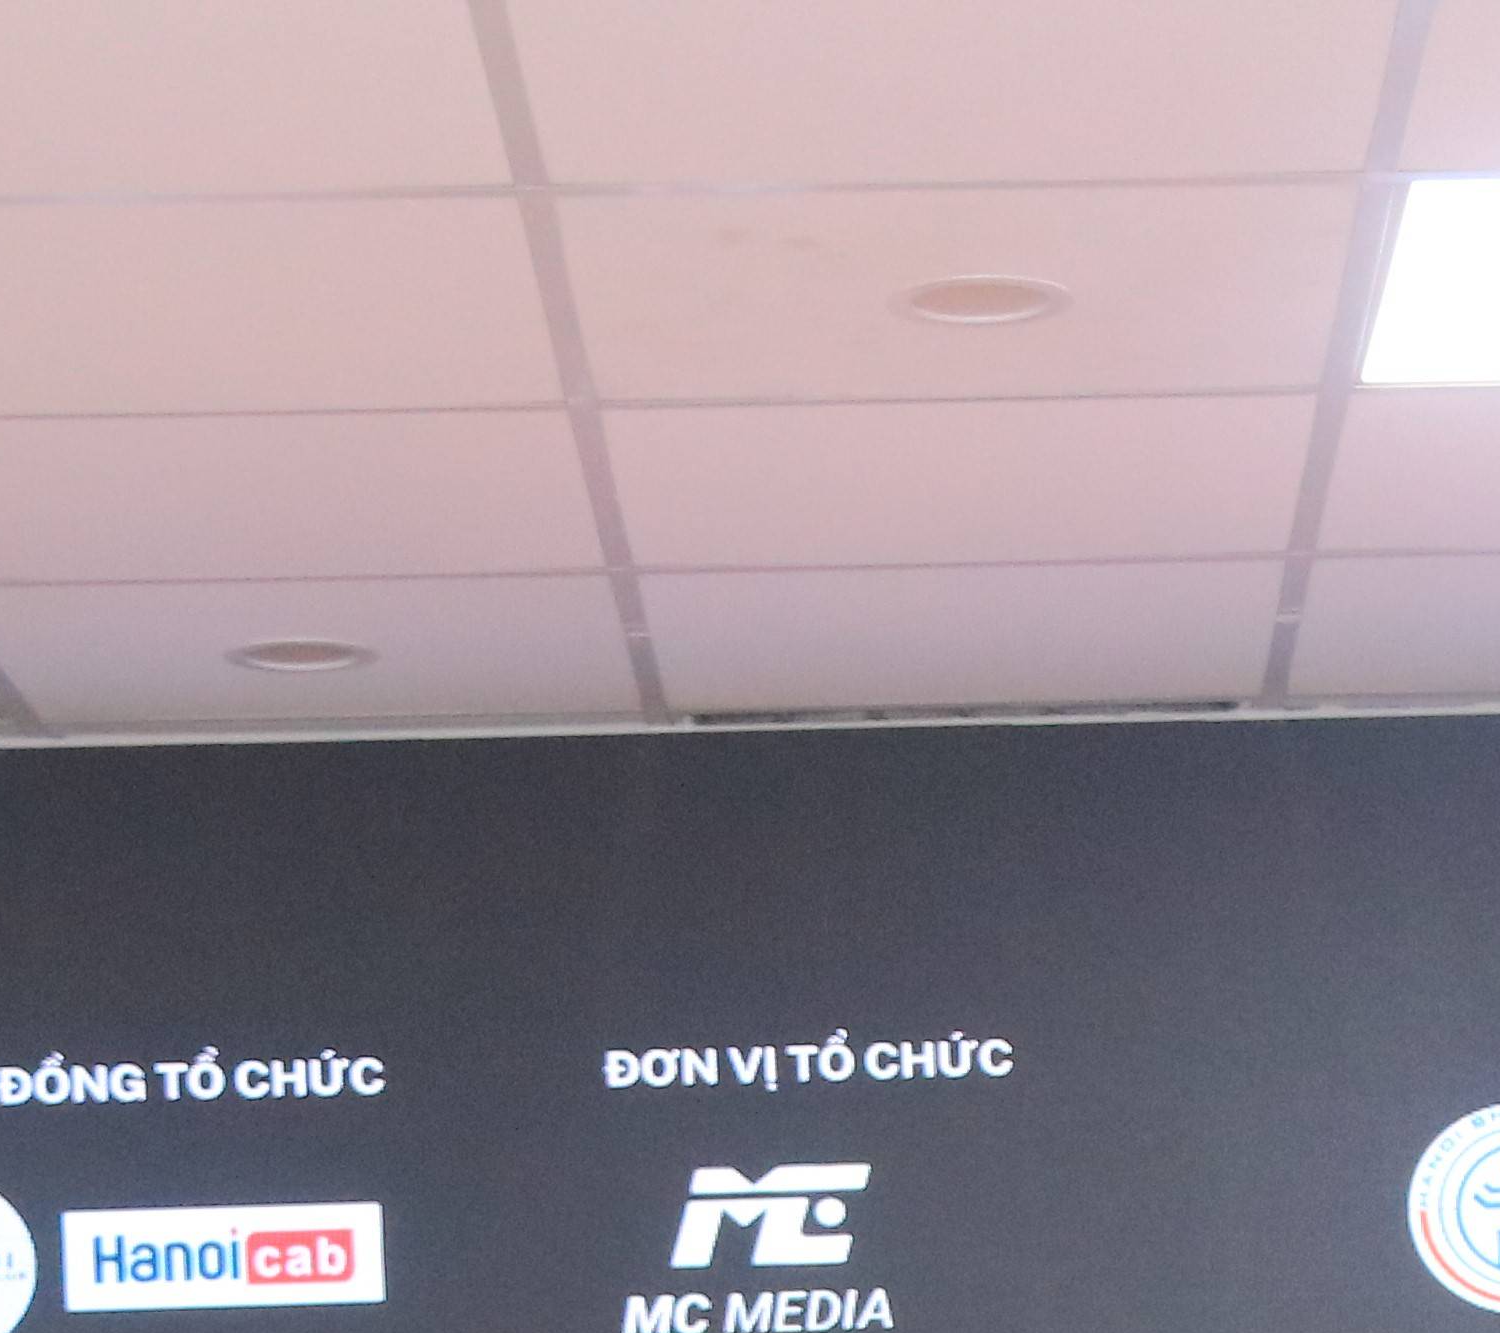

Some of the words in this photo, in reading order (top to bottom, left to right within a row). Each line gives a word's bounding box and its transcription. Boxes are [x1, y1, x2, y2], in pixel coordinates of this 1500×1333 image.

[154, 1046, 226, 1100] TỔ
[234, 1049, 385, 1098] CHỨC
[604, 1047, 718, 1088] ĐƠN
[728, 1045, 777, 1092] VỊ
[786, 1028, 855, 1082] TỔ
[864, 1031, 1013, 1080] CHỨC
[724, 1287, 894, 1333] MEDIA
